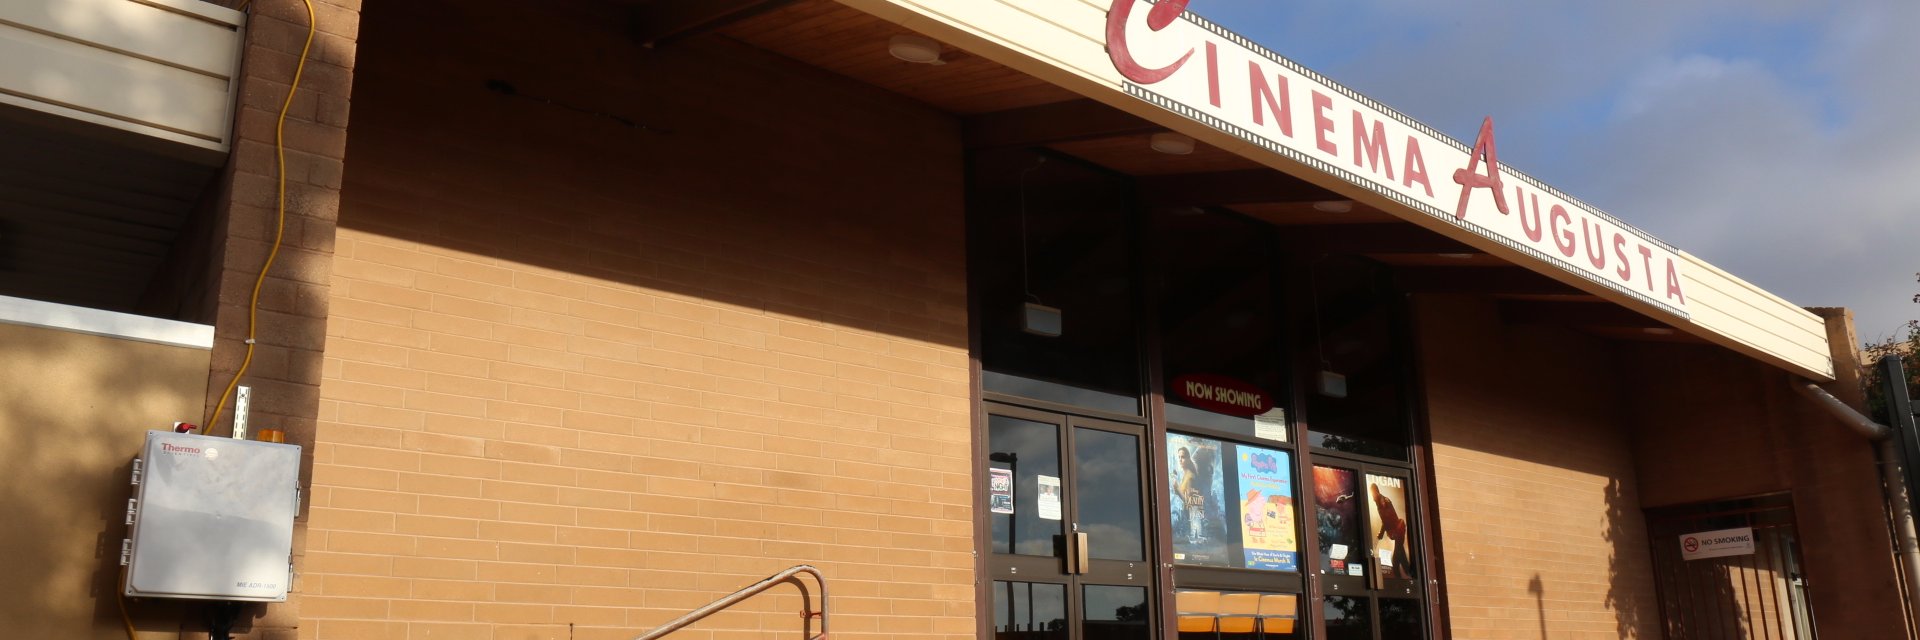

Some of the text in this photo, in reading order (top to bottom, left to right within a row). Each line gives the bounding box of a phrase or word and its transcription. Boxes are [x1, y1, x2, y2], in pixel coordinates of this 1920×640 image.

[1106, 0, 1686, 305] CINEMA AUGUSTA
[1185, 380, 1262, 409] NOW SHOWING
[161, 443, 201, 454] Thermo
[1701, 535, 1750, 546] NO SMOKING
